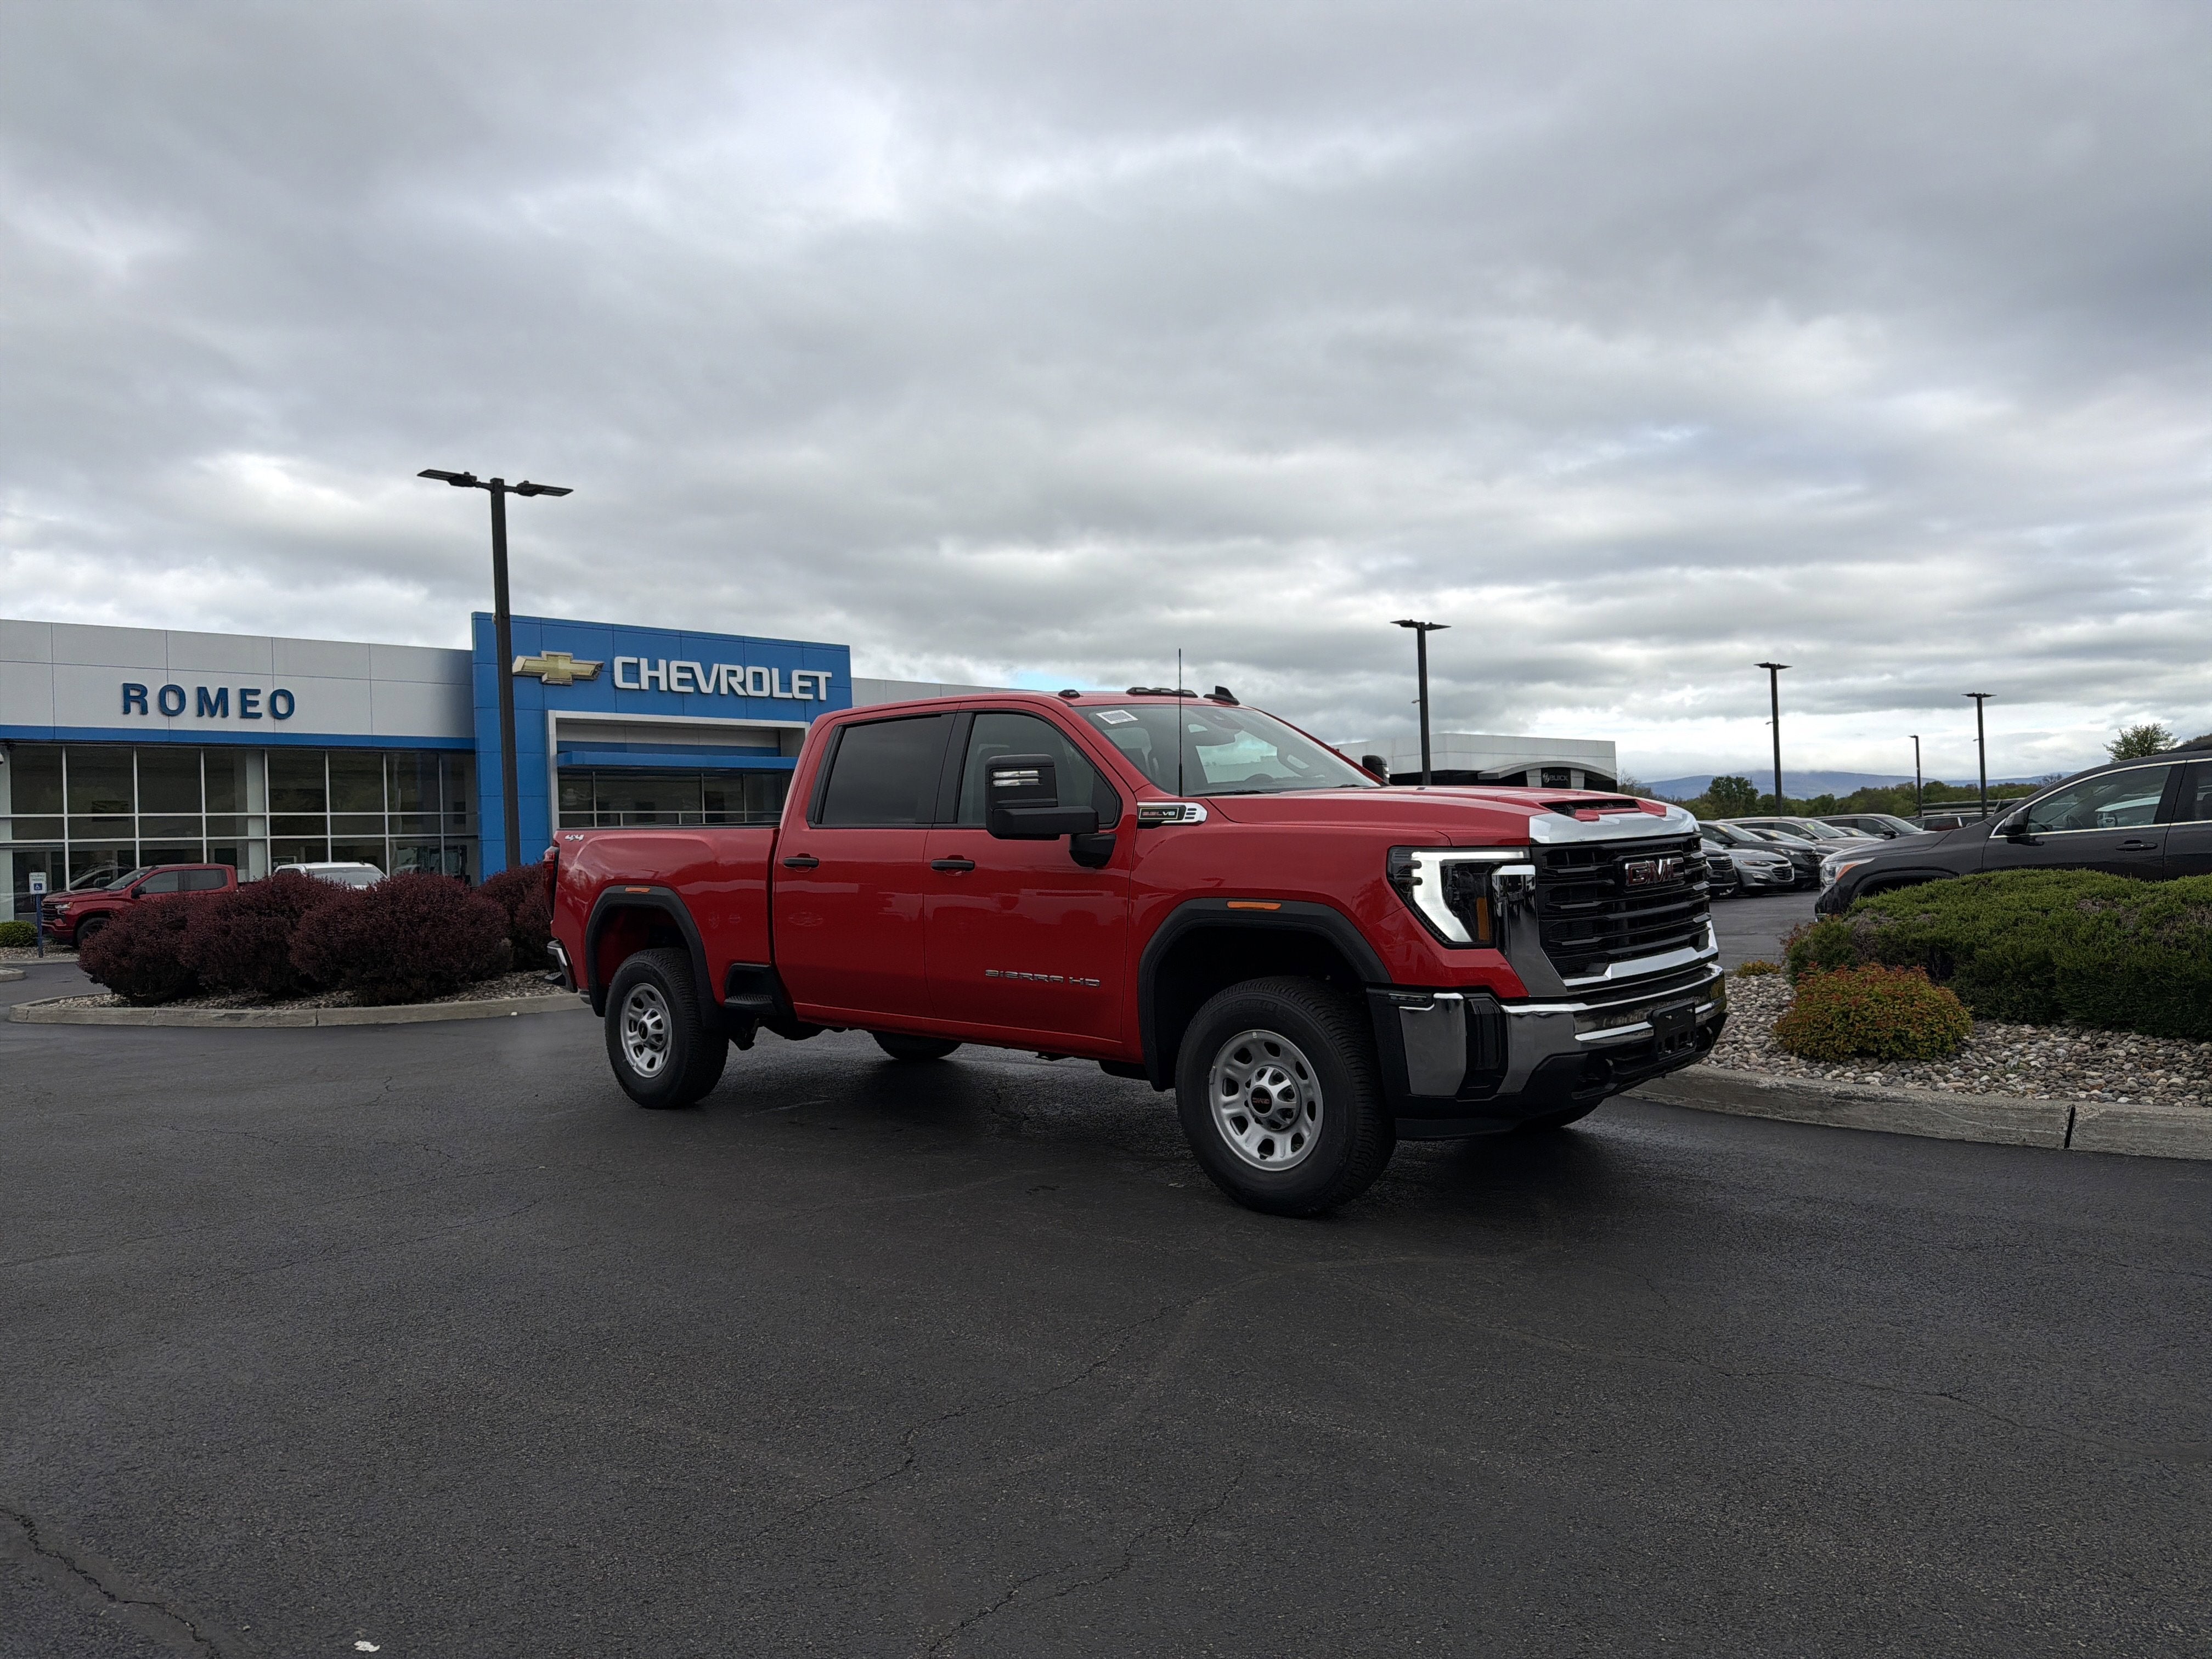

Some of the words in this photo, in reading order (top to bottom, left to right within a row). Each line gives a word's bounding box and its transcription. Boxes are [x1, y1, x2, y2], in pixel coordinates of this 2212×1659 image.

[613, 656, 833, 701] CHEVROLET
[122, 682, 295, 720] ROMEO
[1625, 857, 1684, 887] GMC
[985, 969, 1064, 983] SIERRA
[1069, 977, 1101, 987] HD
